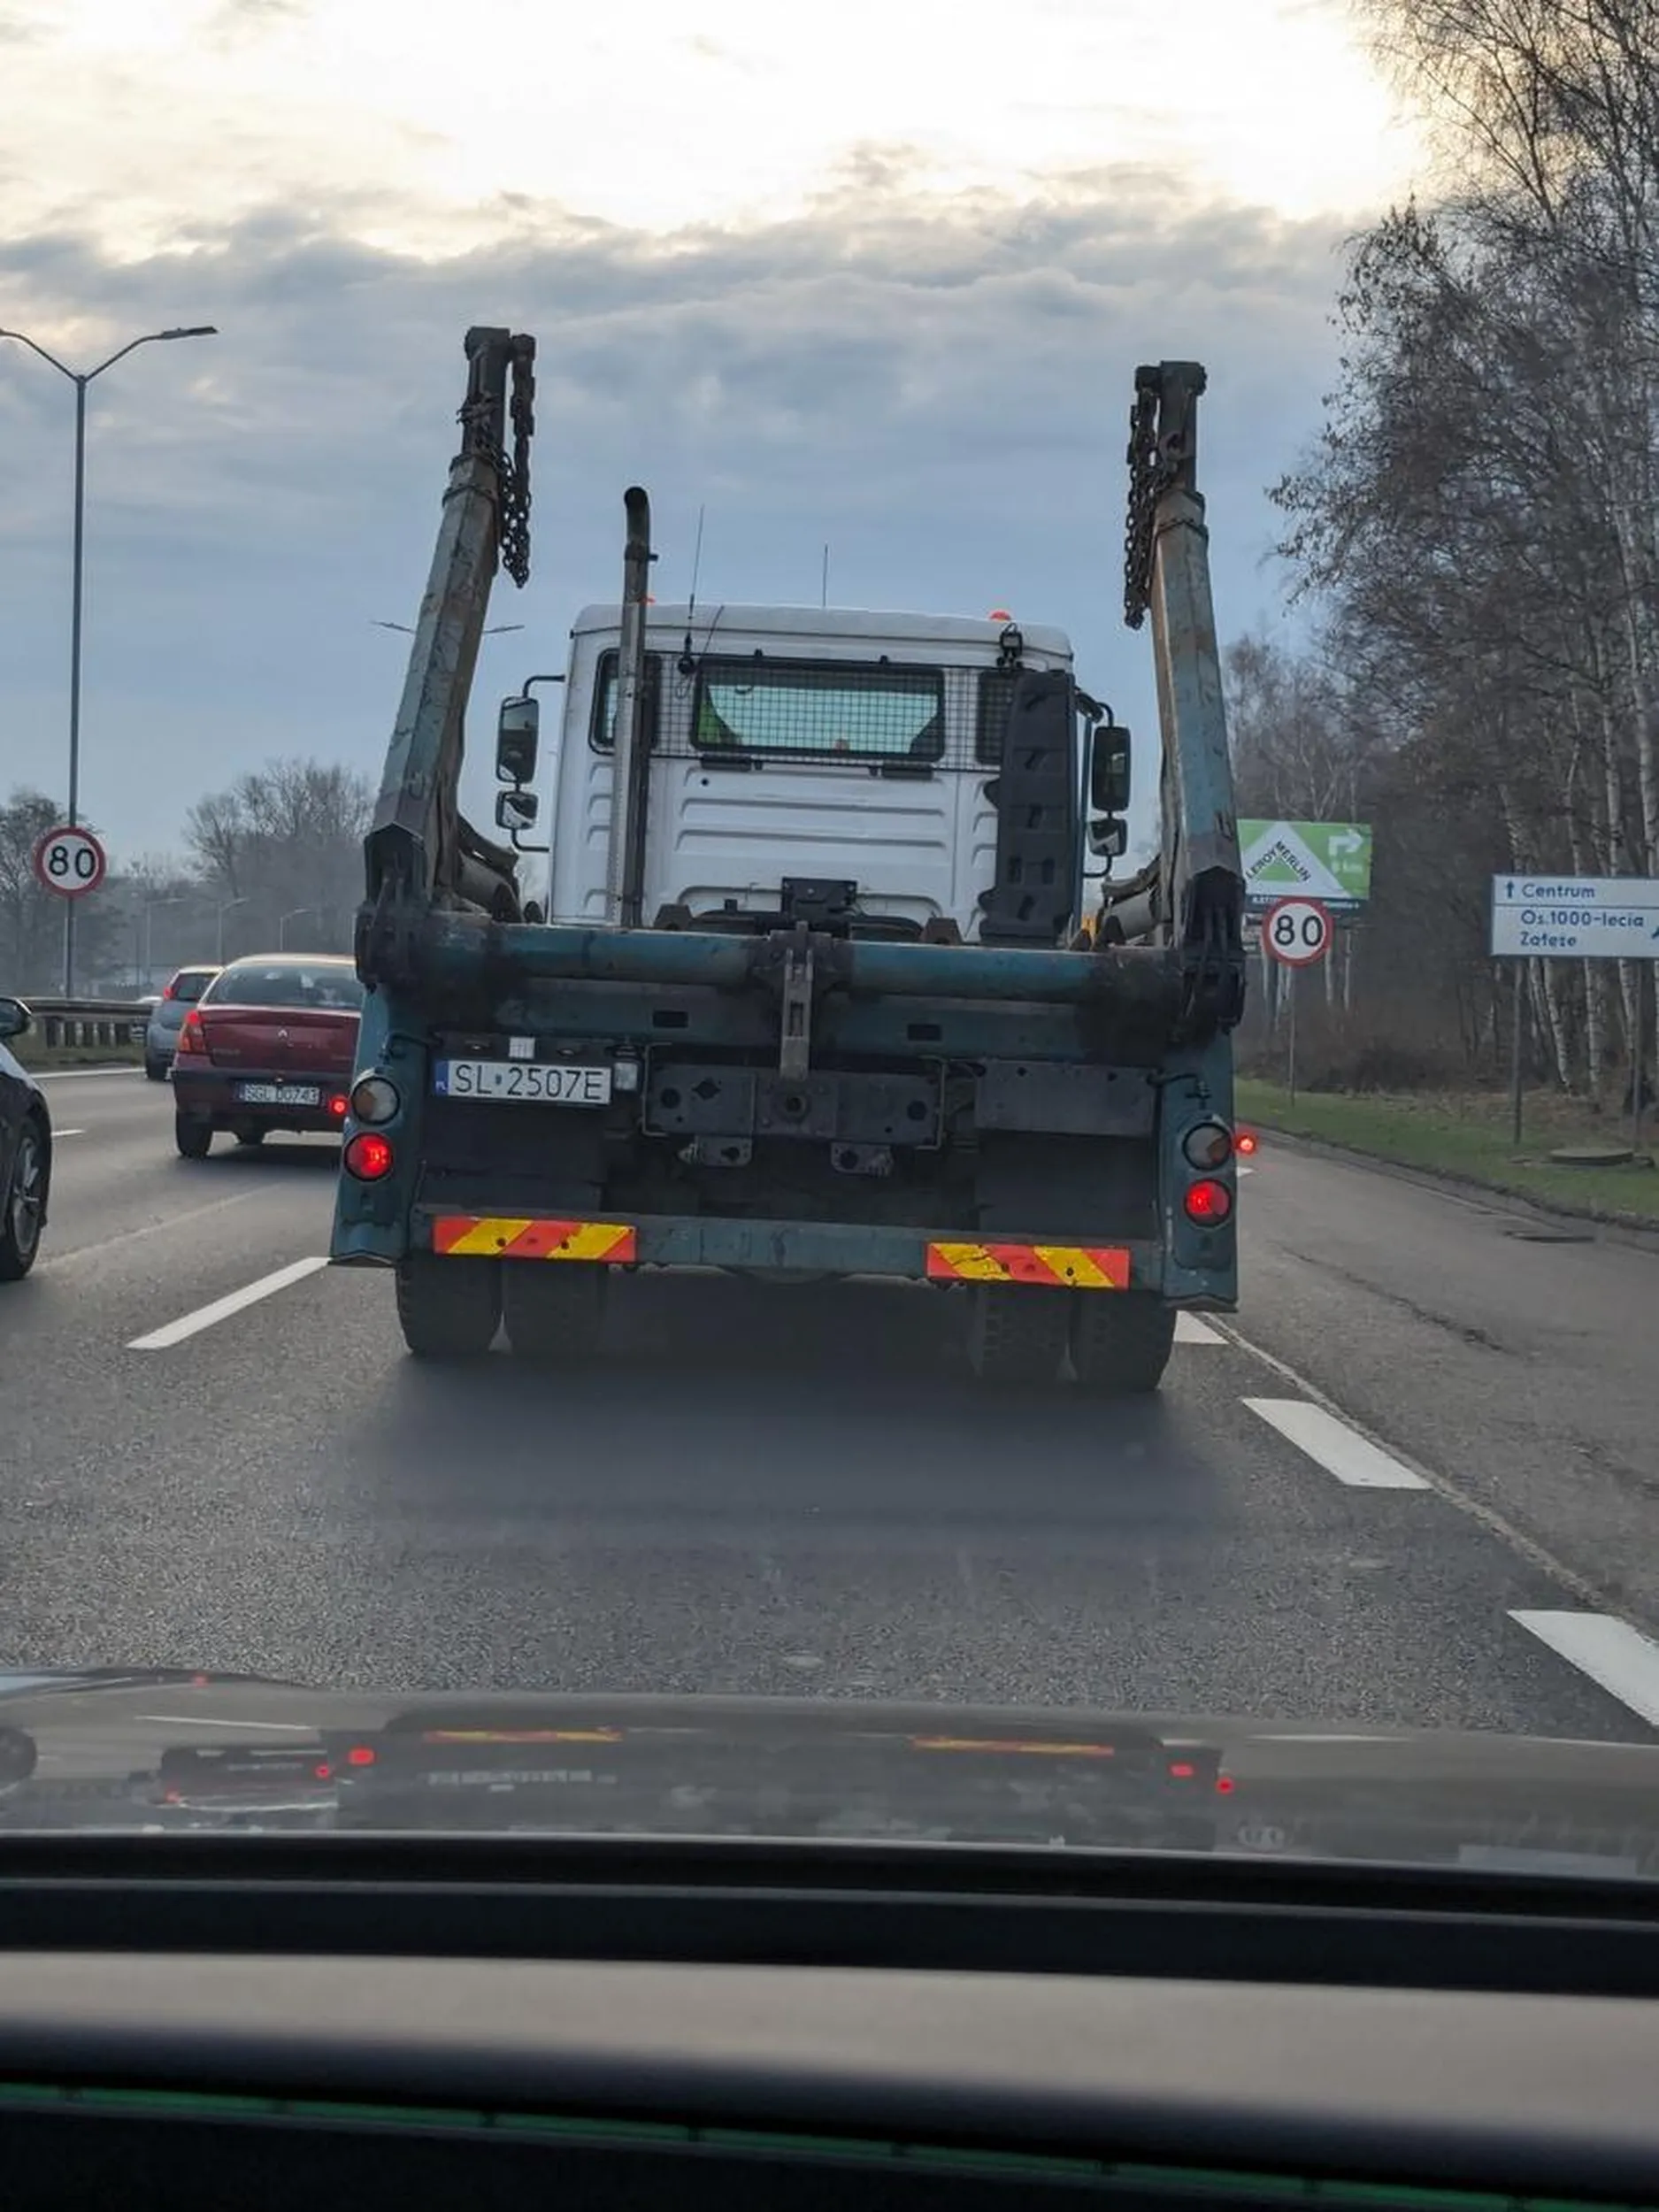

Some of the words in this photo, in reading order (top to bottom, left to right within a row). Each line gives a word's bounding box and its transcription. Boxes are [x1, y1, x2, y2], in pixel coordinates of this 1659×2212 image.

[49, 845, 96, 879] 80
[1245, 847, 1277, 879] LEROY
[1275, 841, 1312, 881] MERLIN
[1521, 883, 1595, 898] Centrum
[1274, 914, 1324, 947] 80
[455, 1064, 492, 1094] SL
[507, 1066, 603, 1100] 2507E
